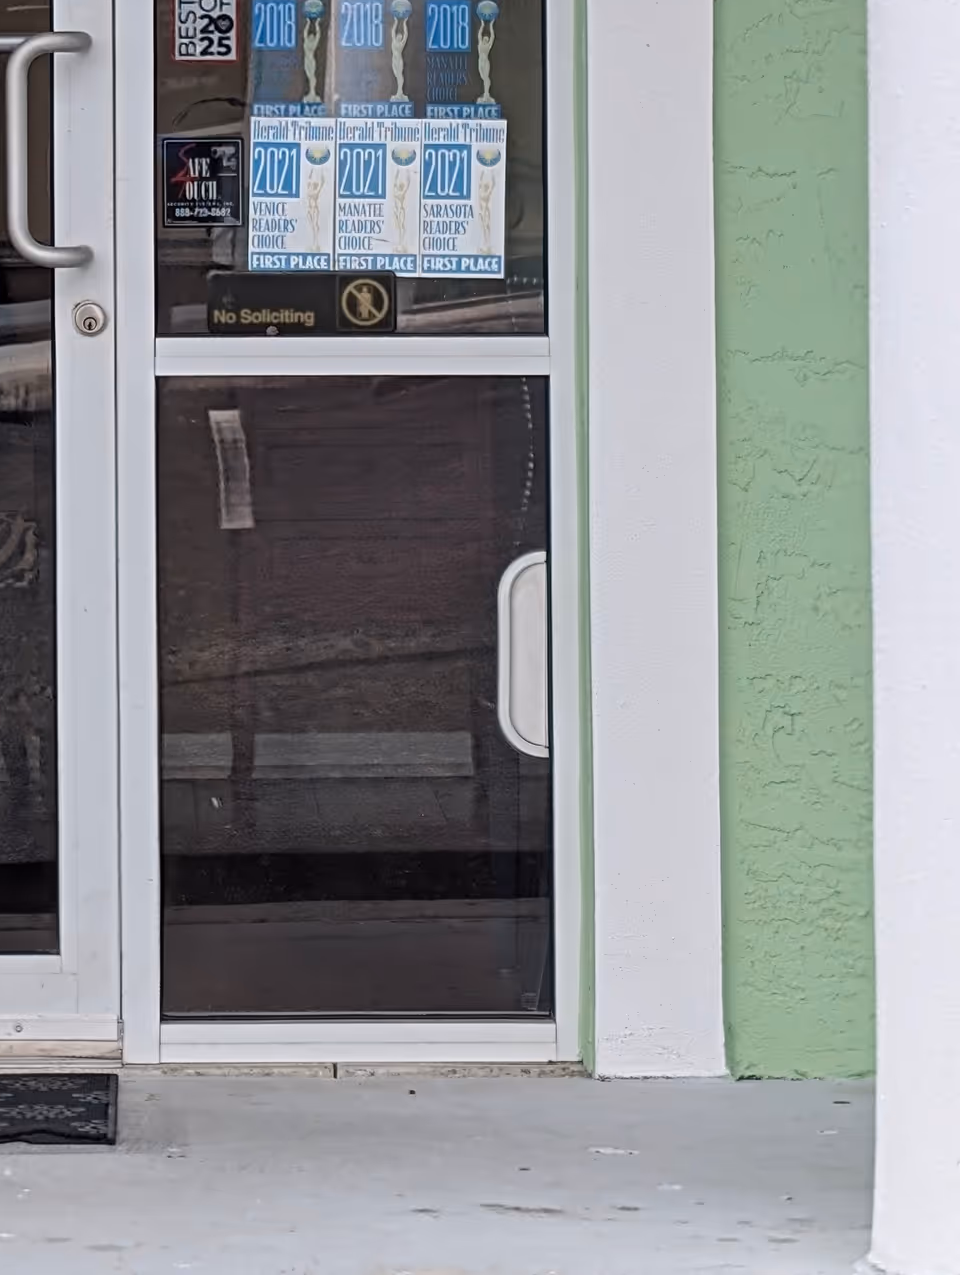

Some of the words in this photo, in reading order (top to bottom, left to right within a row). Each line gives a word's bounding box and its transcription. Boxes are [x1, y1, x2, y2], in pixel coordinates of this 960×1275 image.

[255, 2, 296, 48] 2018
[341, 1, 384, 47] 2018
[428, 4, 470, 49] 2018
[199, 36, 232, 57] 25
[253, 104, 289, 117] FIRST
[291, 104, 327, 117] PLACE
[340, 104, 374, 118] FIRST
[376, 104, 413, 118] PLACE
[426, 106, 460, 119] FIRST
[462, 106, 499, 119] PLACE
[253, 147, 297, 195] 2021
[339, 148, 383, 196] 2021
[424, 149, 468, 196] 2021
[252, 202, 287, 216] VENICE
[338, 203, 385, 218] MANATEE
[423, 204, 474, 219] SARASOTA
[252, 219, 297, 233] READERS'
[338, 220, 385, 234] READERS'
[423, 221, 469, 235] READERS'
[252, 235, 287, 250] CHOICE
[338, 236, 373, 251] CHOICE
[423, 237, 458, 252] CHOICE
[252, 255, 288, 270] FIRST
[290, 255, 329, 270] PLACE
[339, 256, 374, 271] FIRST
[377, 256, 415, 271] PLACE
[423, 257, 458, 272] FIRST
[461, 257, 499, 272] PLACE
[213, 310, 237, 324] No
[240, 308, 315, 327] Soliciting
